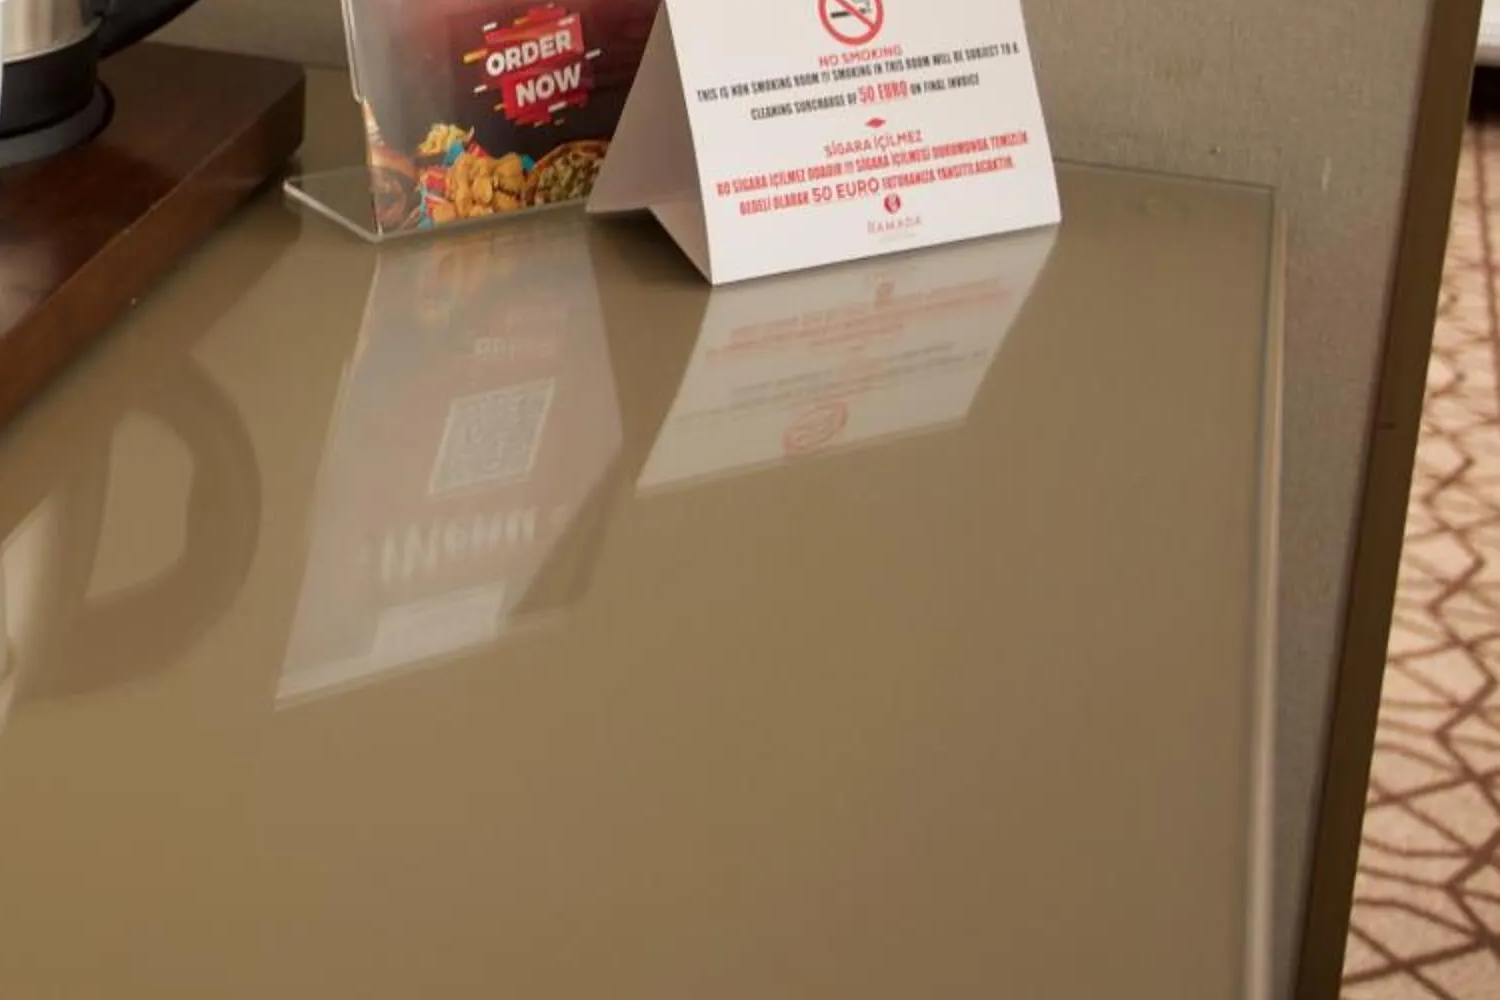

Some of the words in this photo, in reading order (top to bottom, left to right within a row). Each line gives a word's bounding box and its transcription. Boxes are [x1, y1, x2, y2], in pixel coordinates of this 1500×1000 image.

[486, 29, 572, 77] ORDER
[696, 87, 718, 102] THIS
[720, 85, 729, 99] IS
[731, 83, 750, 97] NON
[751, 77, 792, 95] SMOKING
[793, 72, 819, 87] ROOM
[832, 63, 872, 80] SMOKING
[873, 63, 883, 75] IN
[885, 59, 904, 73] THIS
[906, 56, 931, 71] ROOM
[932, 52, 952, 66] WILL
[954, 49, 964, 63] BE
[965, 44, 999, 61] SUBJECT
[1000, 42, 1011, 55] TO
[819, 55, 839, 68] NO
[842, 46, 902, 63] SMOKING
[515, 62, 581, 108] NOW
[750, 104, 793, 120] CLEANING
[795, 95, 845, 114] SURCHARGE
[847, 91, 857, 105] OF
[858, 83, 875, 104] 50
[877, 80, 908, 101] EURO
[910, 82, 922, 96] ON
[923, 77, 947, 93] FINAL
[948, 72, 980, 89] INVOICE
[812, 185, 832, 203] 50
[835, 177, 880, 199] EURO
